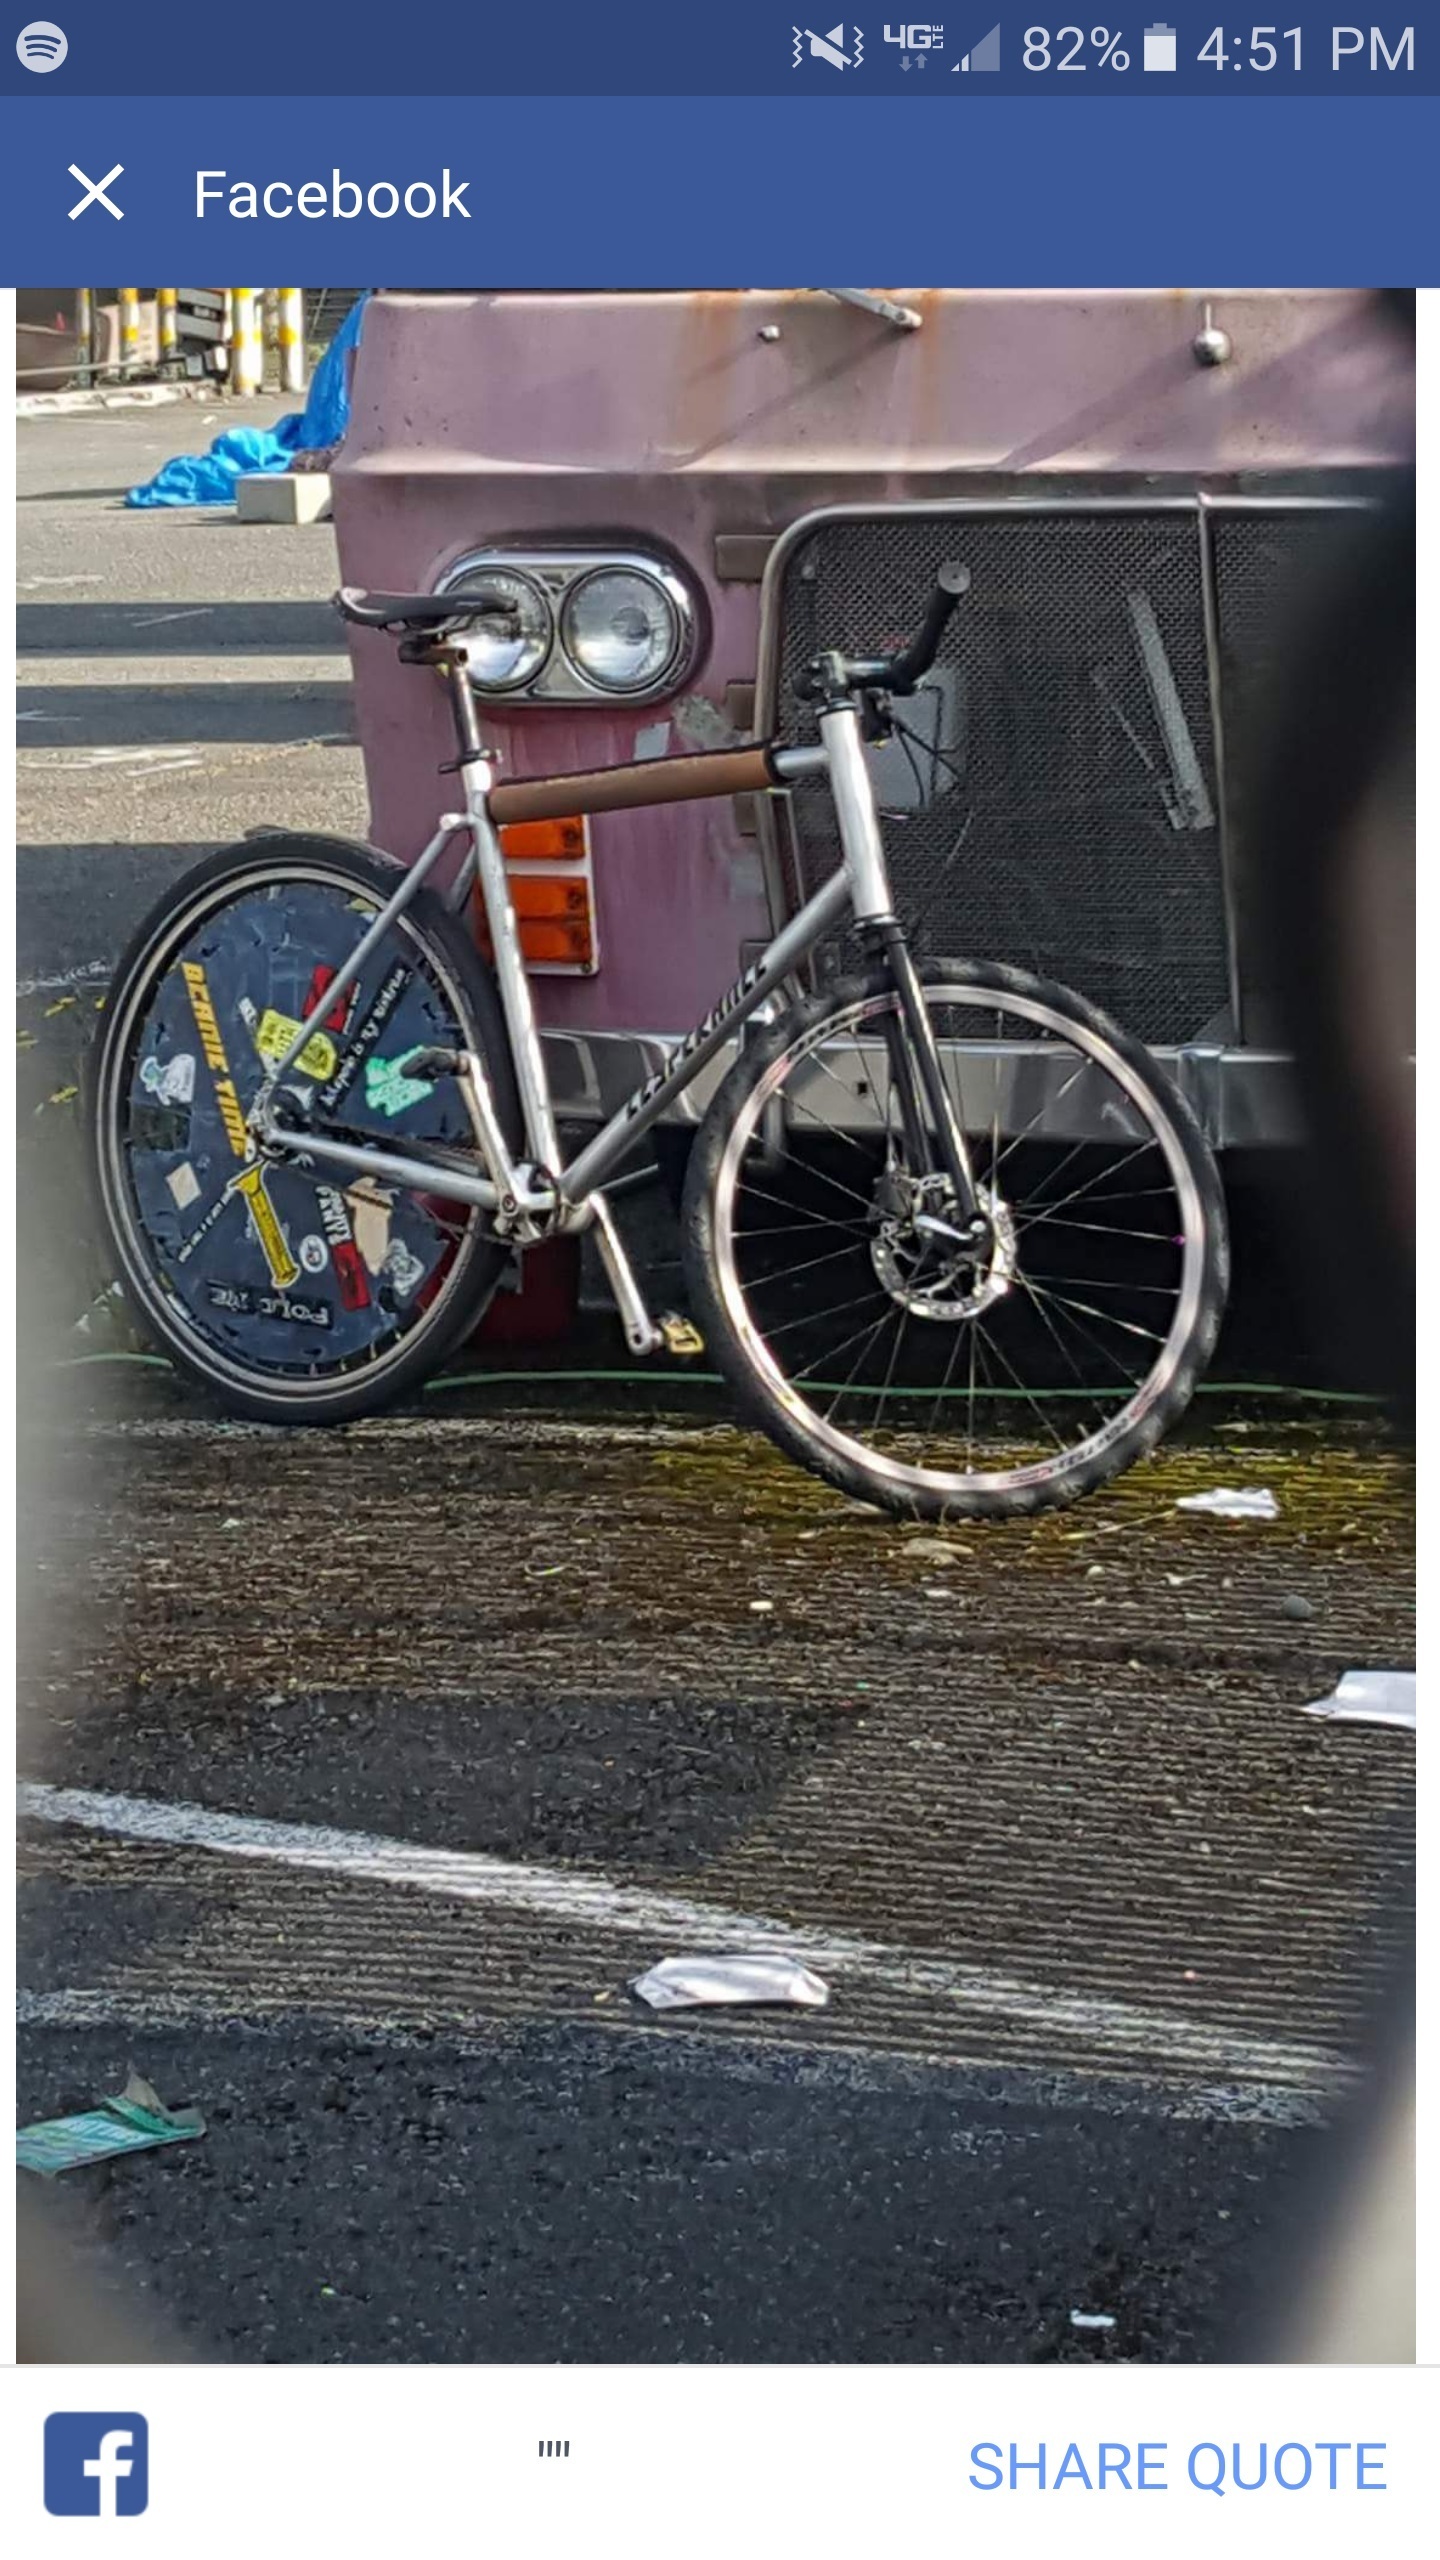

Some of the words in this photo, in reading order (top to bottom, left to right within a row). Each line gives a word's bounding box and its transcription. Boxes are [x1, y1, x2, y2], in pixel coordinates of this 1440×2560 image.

[884, 25, 931, 49] 4G
[932, 25, 944, 49] LTE
[1023, 26, 1131, 72] 82%
[1197, 26, 1301, 72] 4:51
[1333, 27, 1414, 71] PM
[196, 168, 472, 219] Facebook
[969, 2441, 1169, 2491] SHARE
[1187, 2441, 1388, 2498] QUOTE
